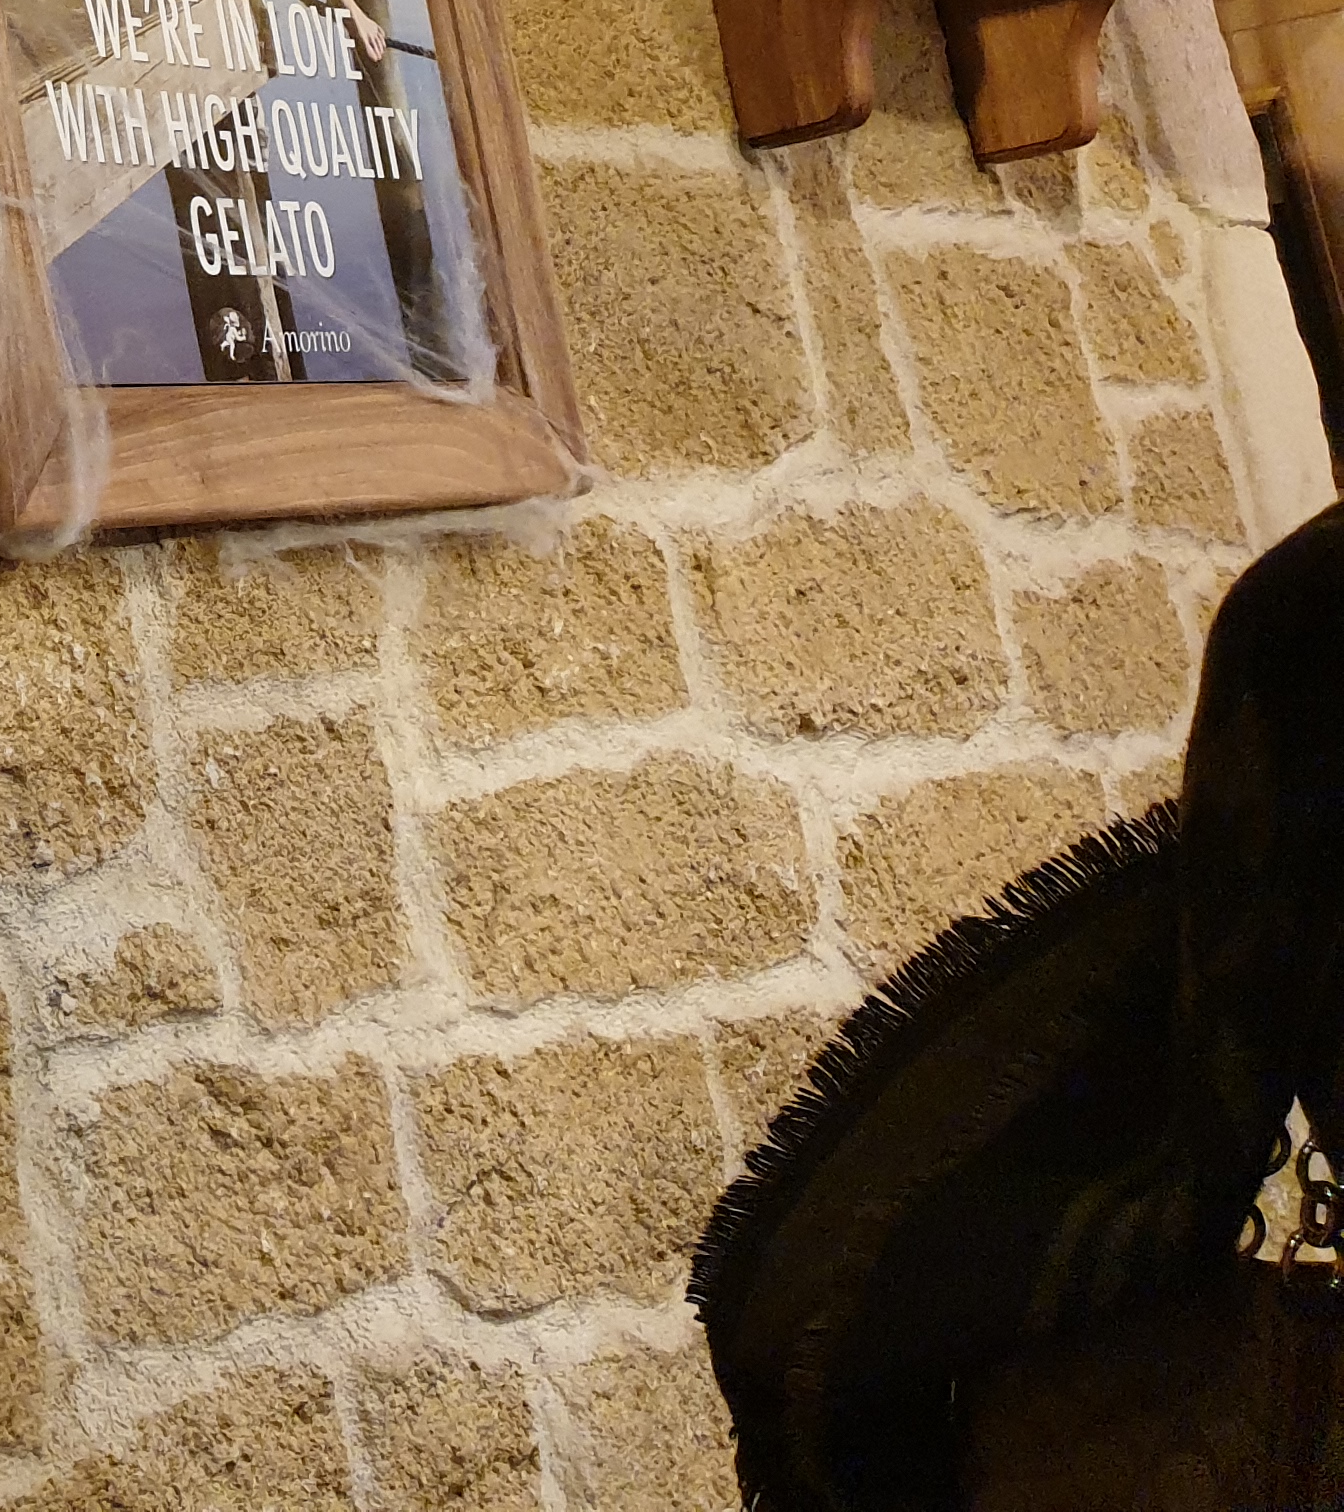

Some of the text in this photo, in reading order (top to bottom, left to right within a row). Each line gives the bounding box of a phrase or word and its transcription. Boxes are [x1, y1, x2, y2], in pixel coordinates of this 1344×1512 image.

[263, 0, 363, 81] LOVE
[45, 79, 424, 181] WITH HIGH QUALITY
[188, 195, 336, 279] GELATO
[261, 318, 351, 353] Amorino
